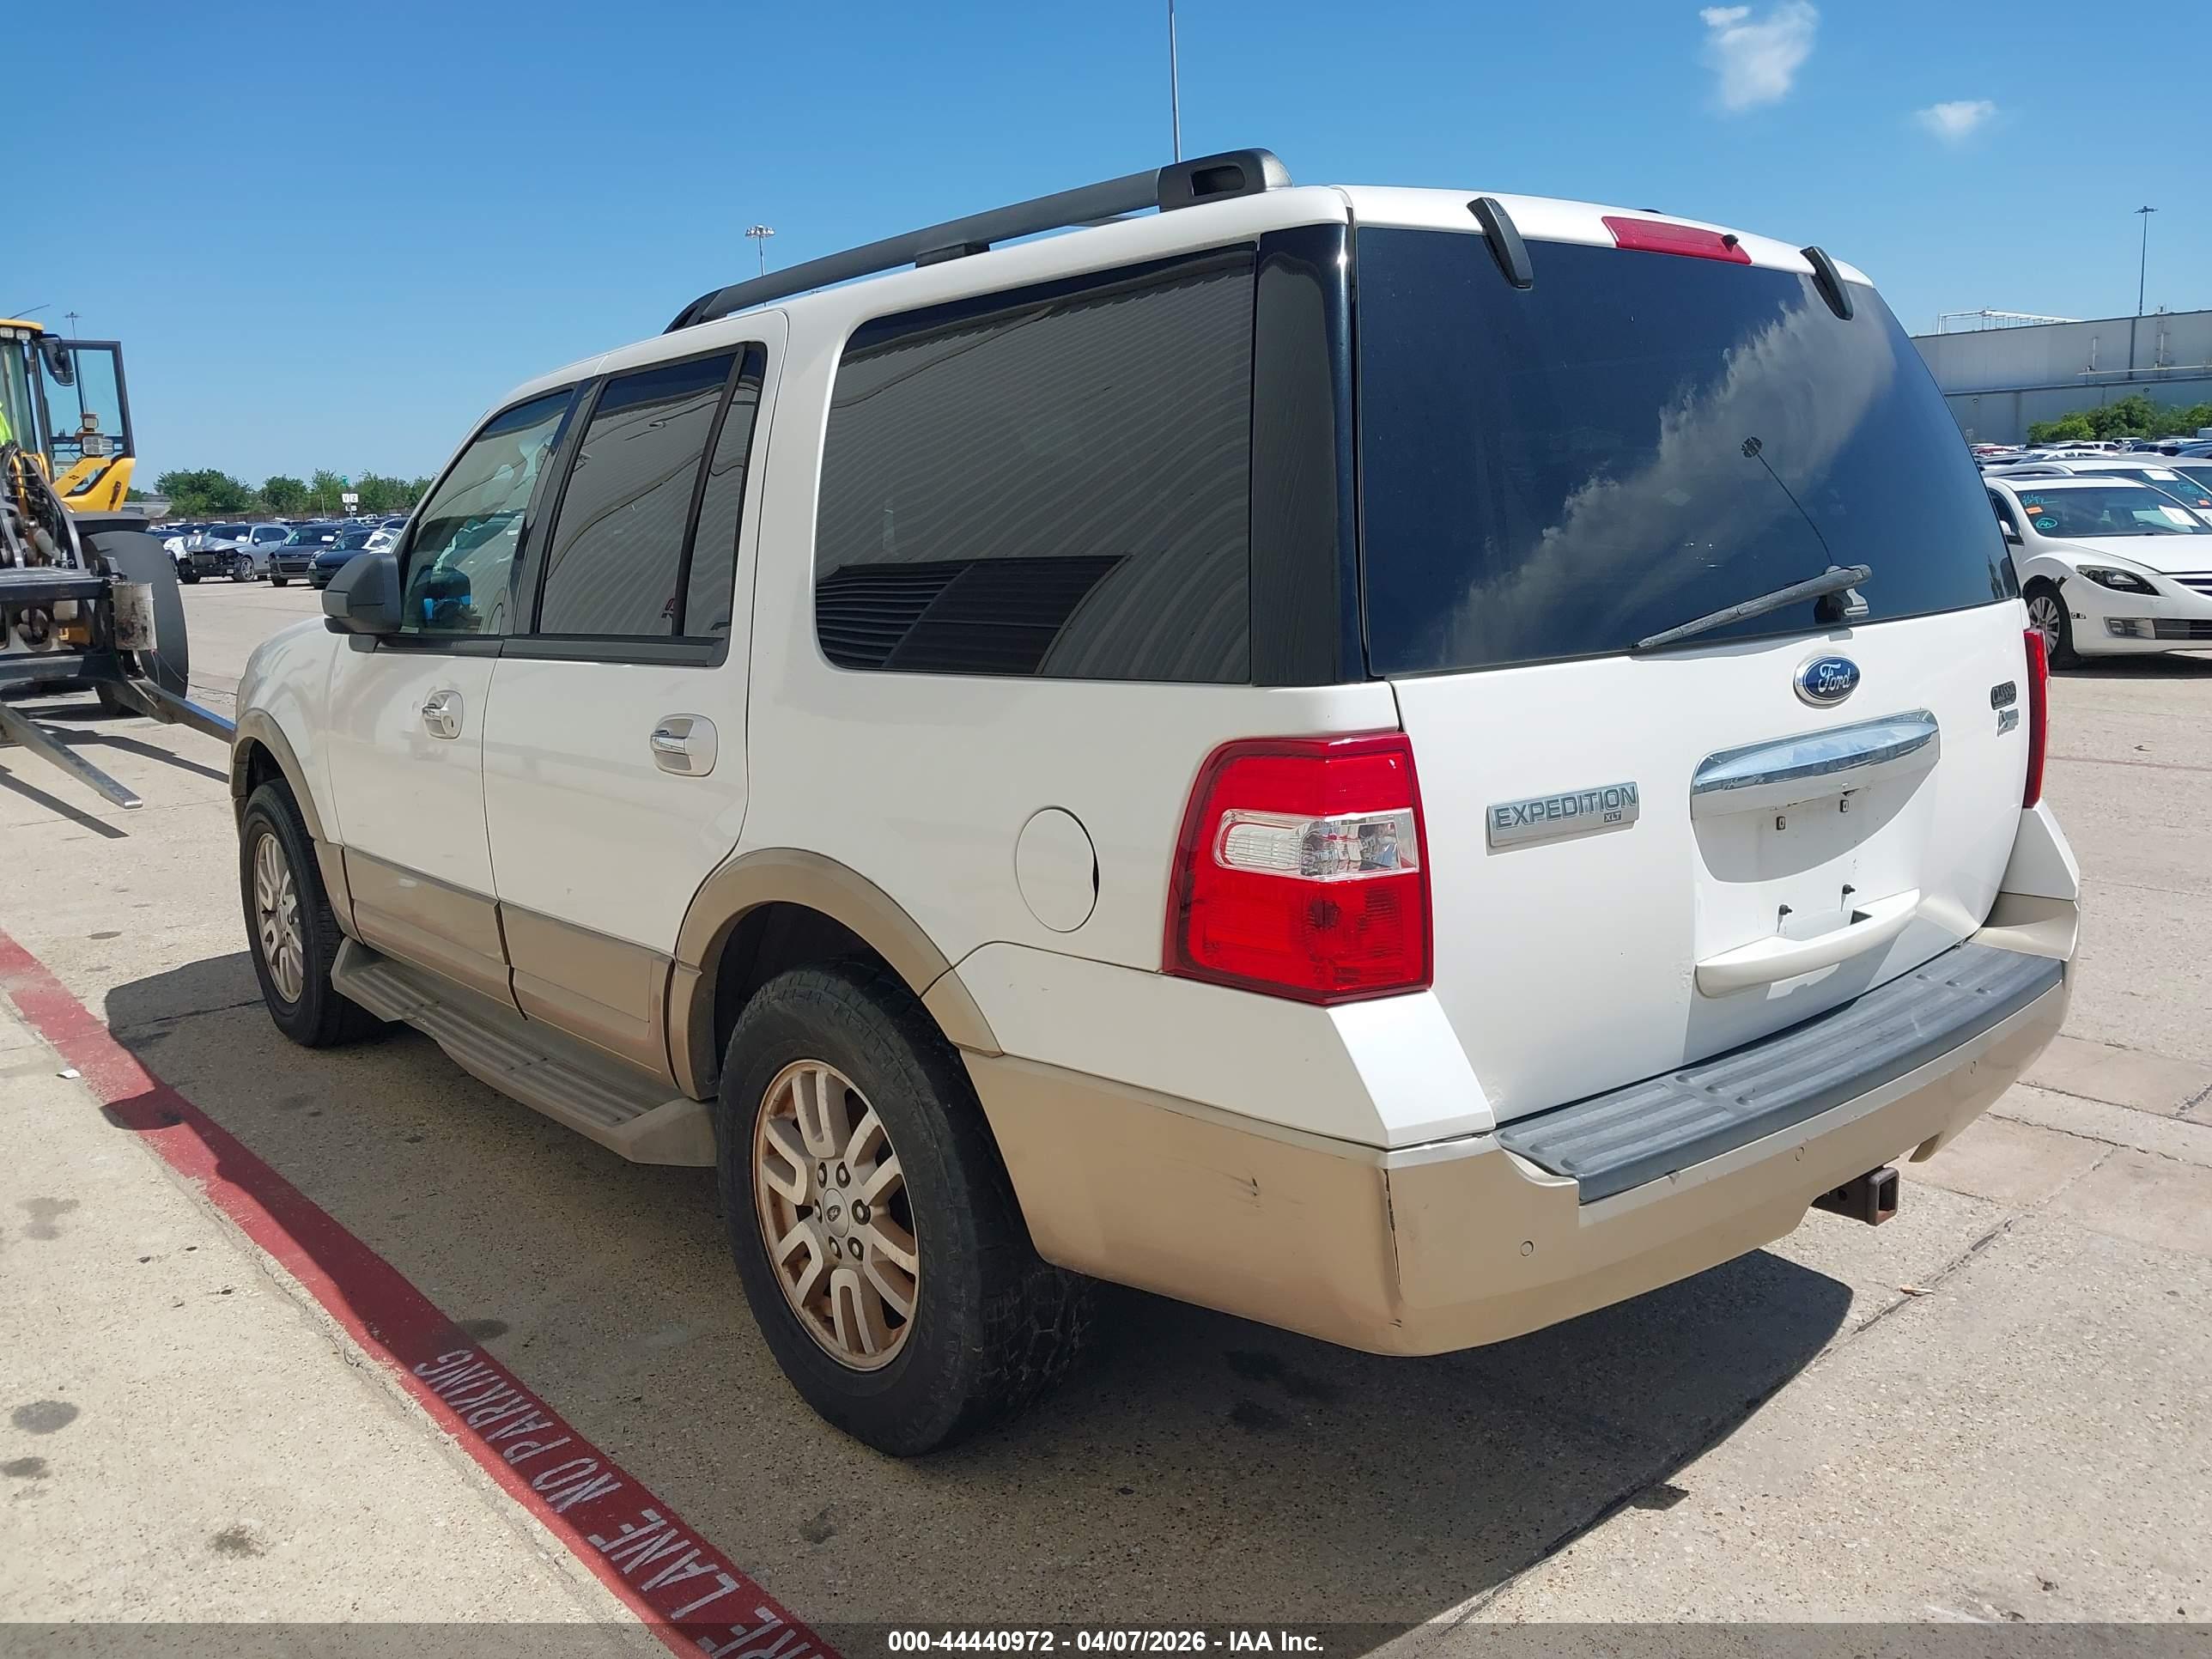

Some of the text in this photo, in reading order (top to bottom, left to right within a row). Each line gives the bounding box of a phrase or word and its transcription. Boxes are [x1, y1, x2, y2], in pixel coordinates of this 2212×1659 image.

[1818, 663, 1851, 693] Ford
[1495, 786, 1637, 830] EXPEDITION
[1604, 811, 1622, 823] XLT
[414, 1349, 570, 1463] PARKING
[532, 1457, 622, 1513] NO
[589, 1509, 740, 1620] LANE
